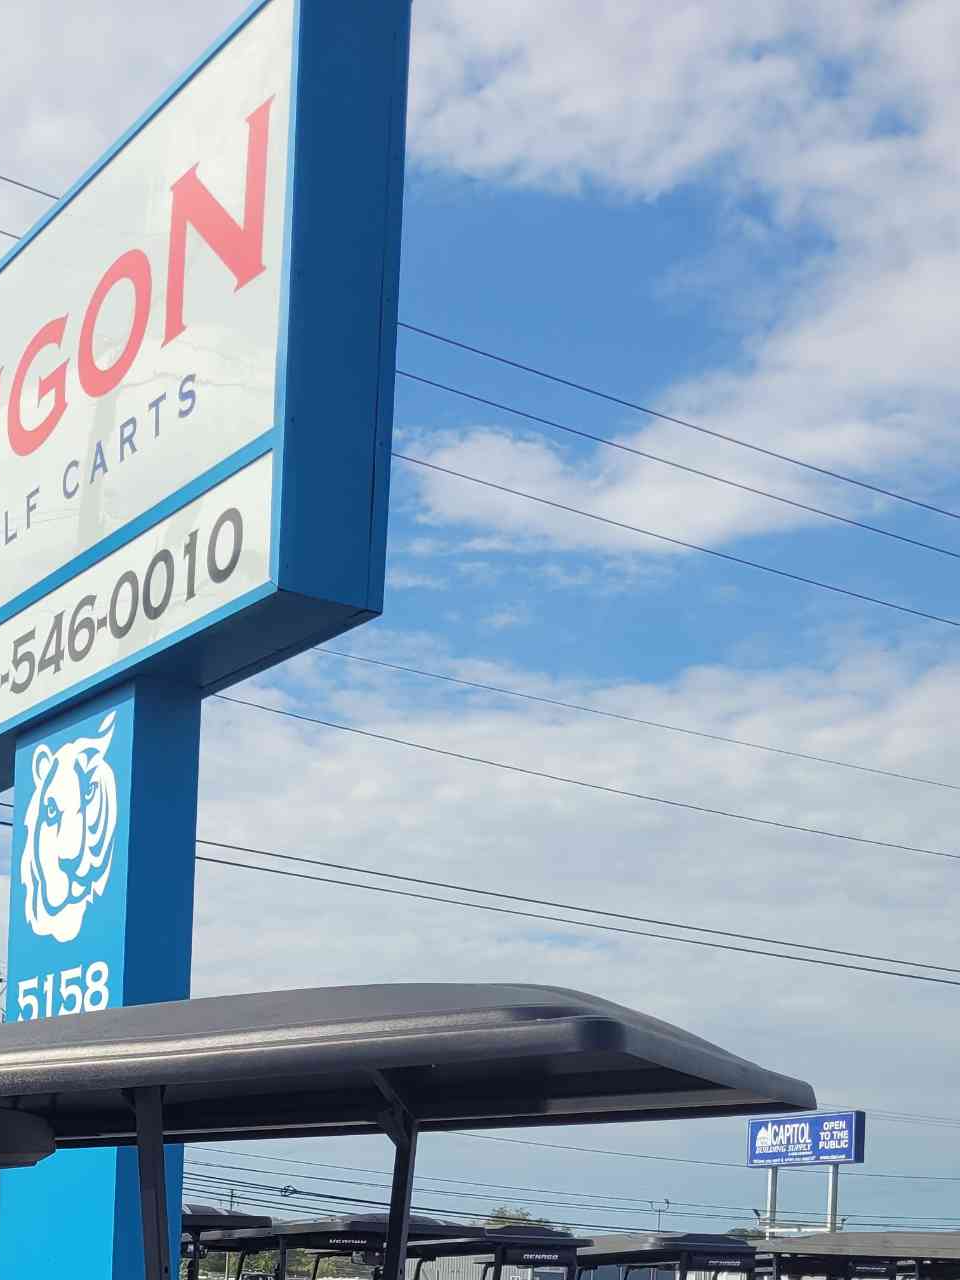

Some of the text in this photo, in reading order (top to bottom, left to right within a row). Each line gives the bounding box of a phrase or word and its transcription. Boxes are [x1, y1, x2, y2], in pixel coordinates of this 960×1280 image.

[62, 374, 197, 499] CARTS
[17, 961, 109, 1022] 5158
[823, 1120, 846, 1130] OPEN
[771, 1123, 811, 1145] CAPITOL
[819, 1130, 848, 1140] TO THE
[819, 1140, 848, 1150] PUBLIC
